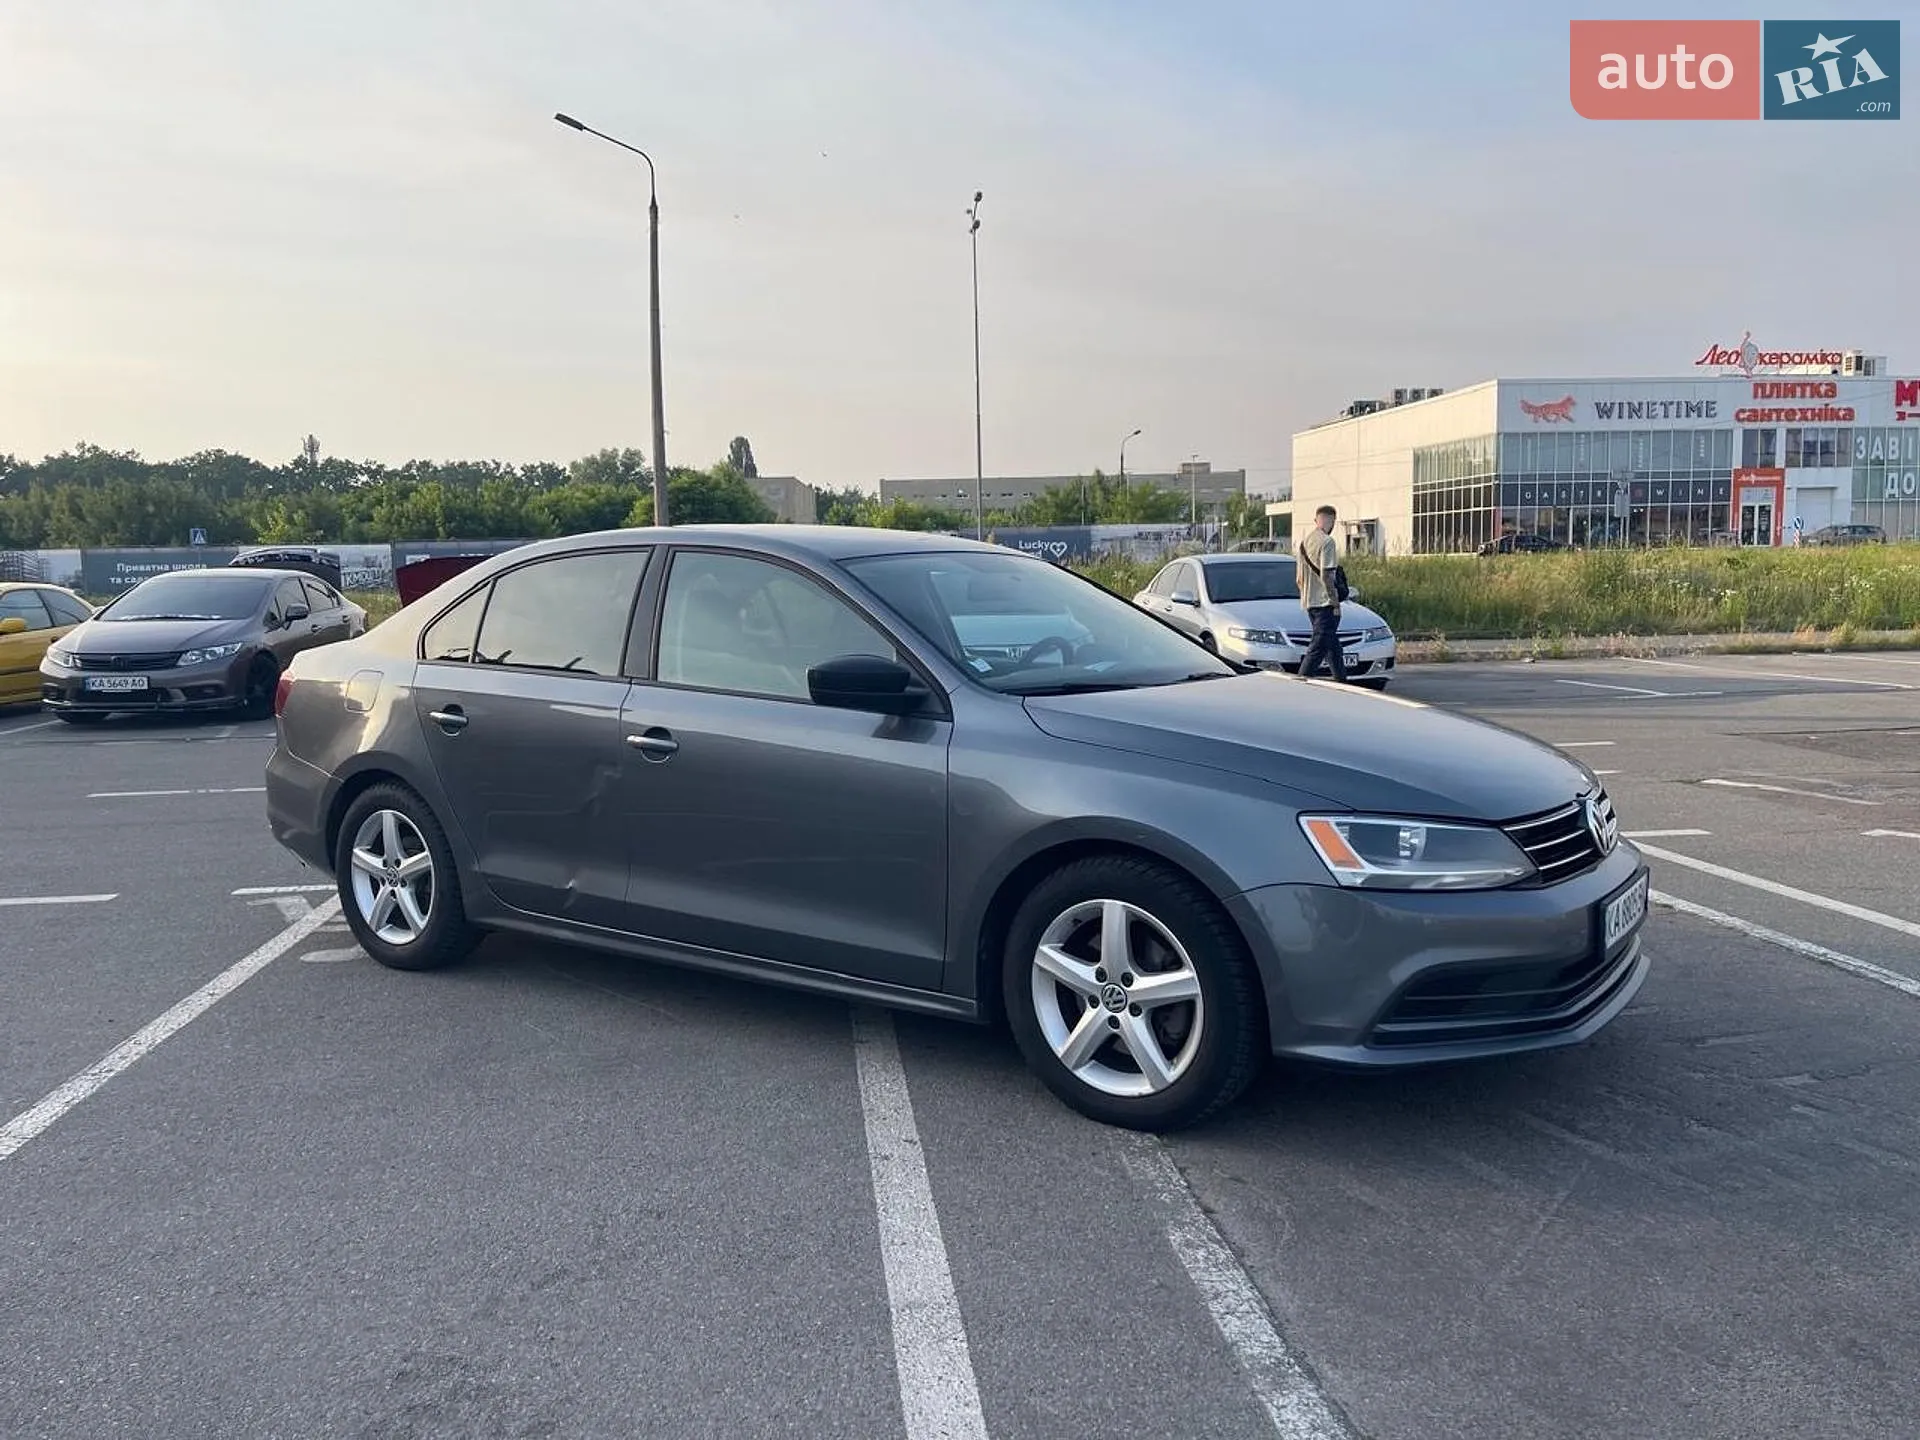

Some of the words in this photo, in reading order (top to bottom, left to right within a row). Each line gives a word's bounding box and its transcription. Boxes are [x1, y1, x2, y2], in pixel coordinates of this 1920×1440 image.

[1695, 343, 1741, 366] Лео
[1758, 349, 1843, 368] кераміка
[1753, 382, 1838, 399] плитка
[1594, 400, 1718, 419] WINETIME
[1734, 403, 1855, 423] сантехніка
[1018, 540, 1050, 551] Lucky
[117, 563, 170, 573] Приватна
